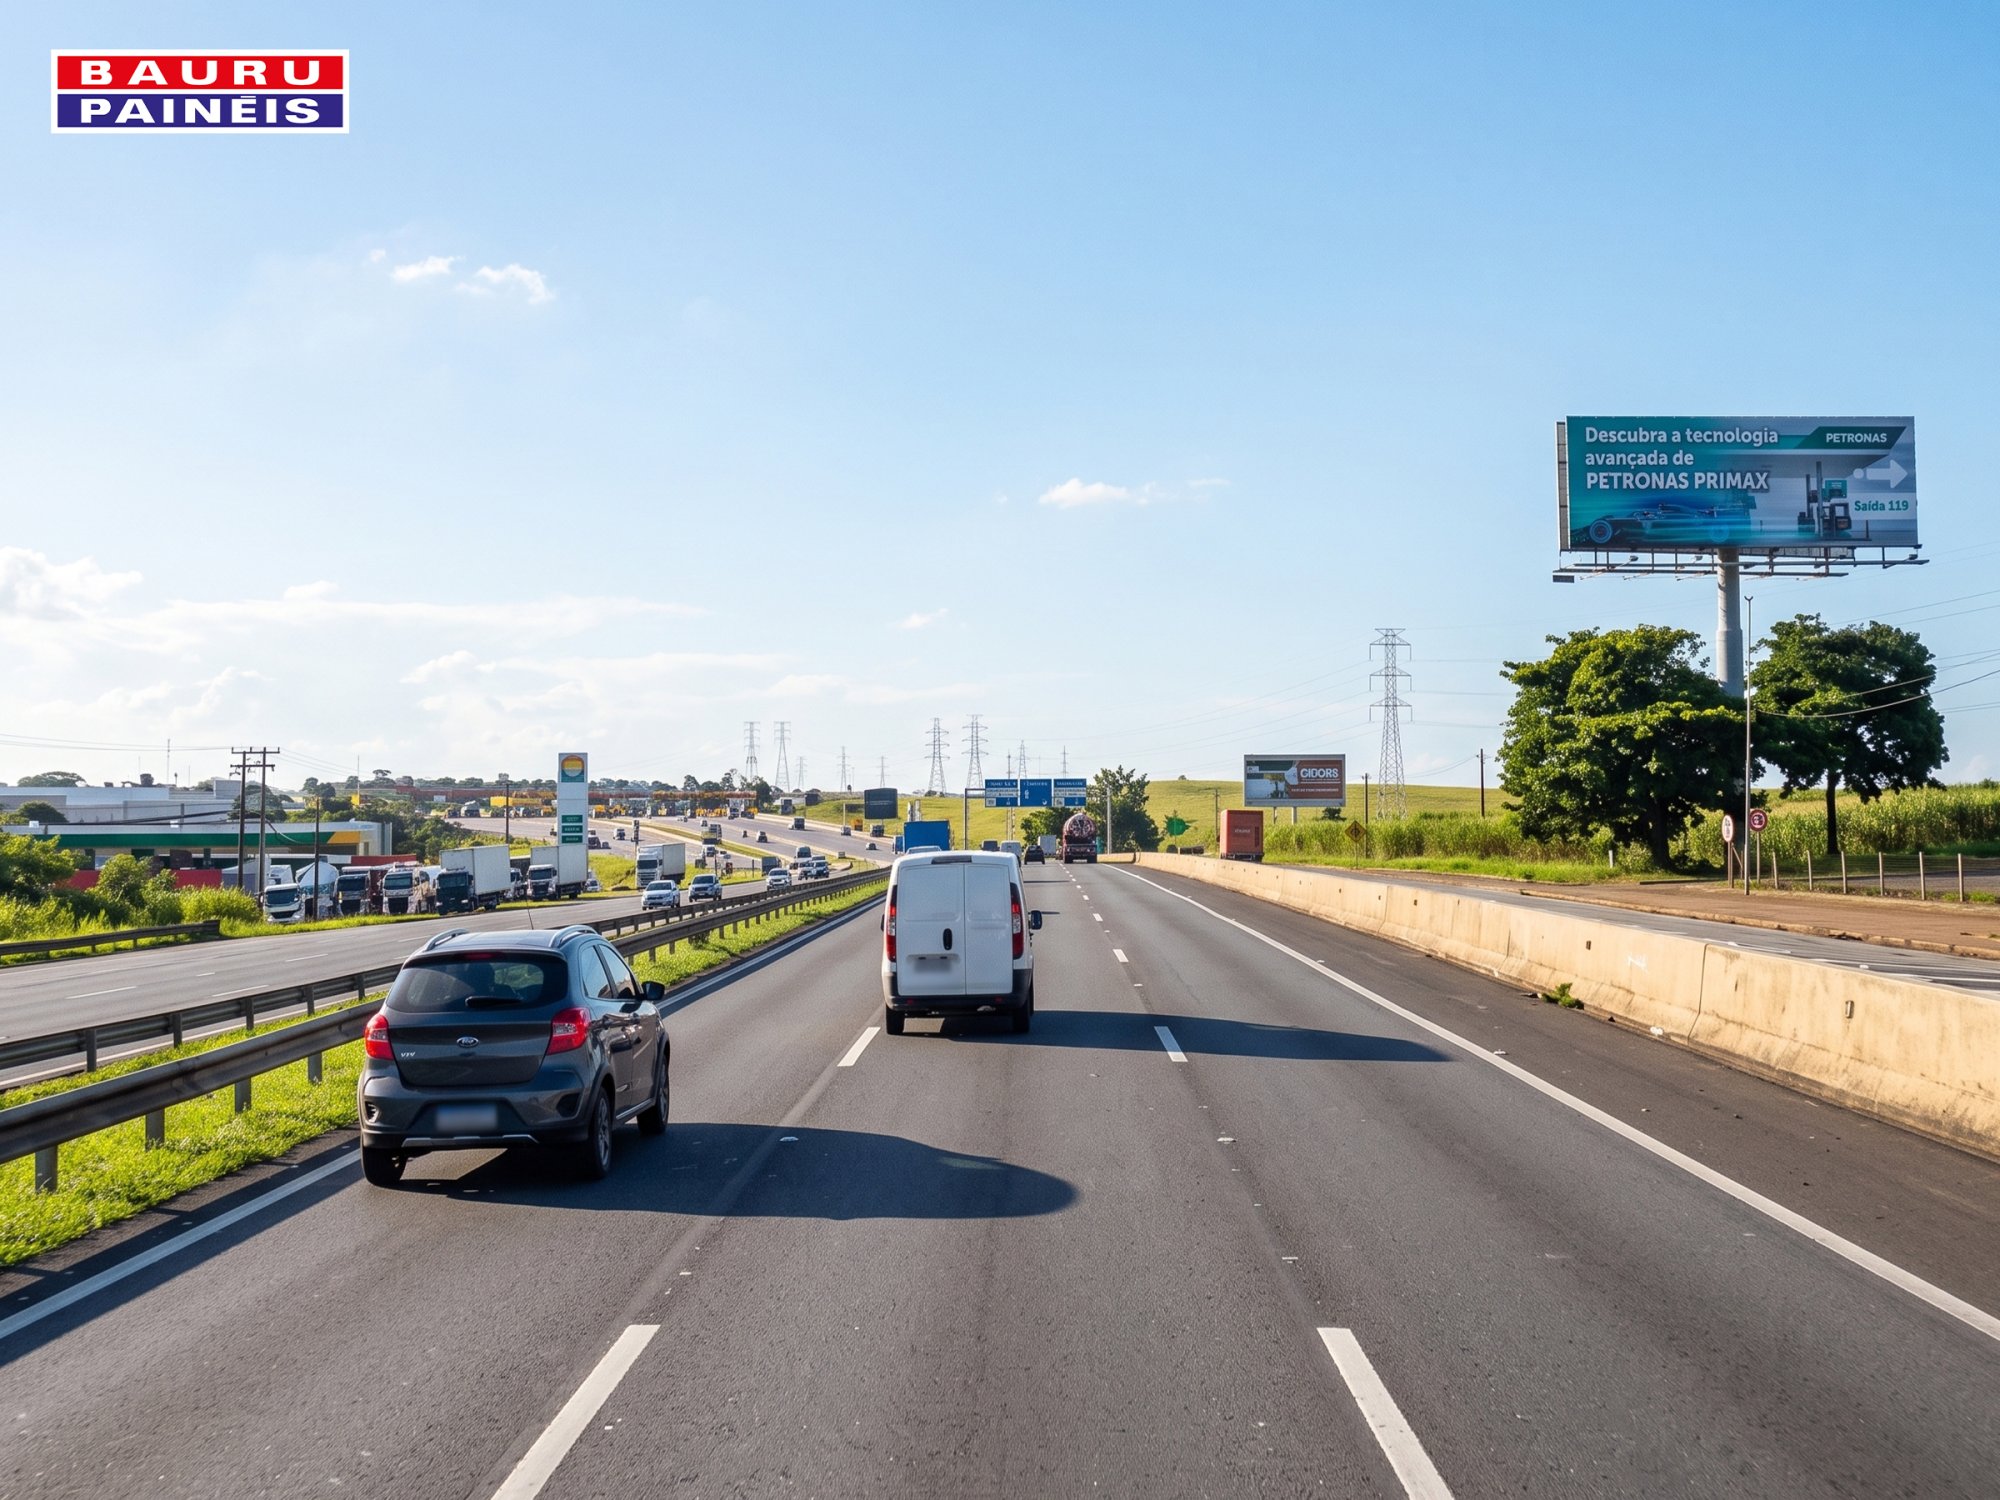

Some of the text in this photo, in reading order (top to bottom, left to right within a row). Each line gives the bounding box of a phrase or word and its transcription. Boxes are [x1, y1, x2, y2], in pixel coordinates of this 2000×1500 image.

[1585, 427, 1778, 447] Descubra a tecnologia
[1826, 433, 1887, 443] PETRONAS
[1585, 450, 1694, 469] avançada de
[1586, 472, 1769, 489] PETRONAS PRIMAX
[1854, 500, 1909, 511] Saída 119
